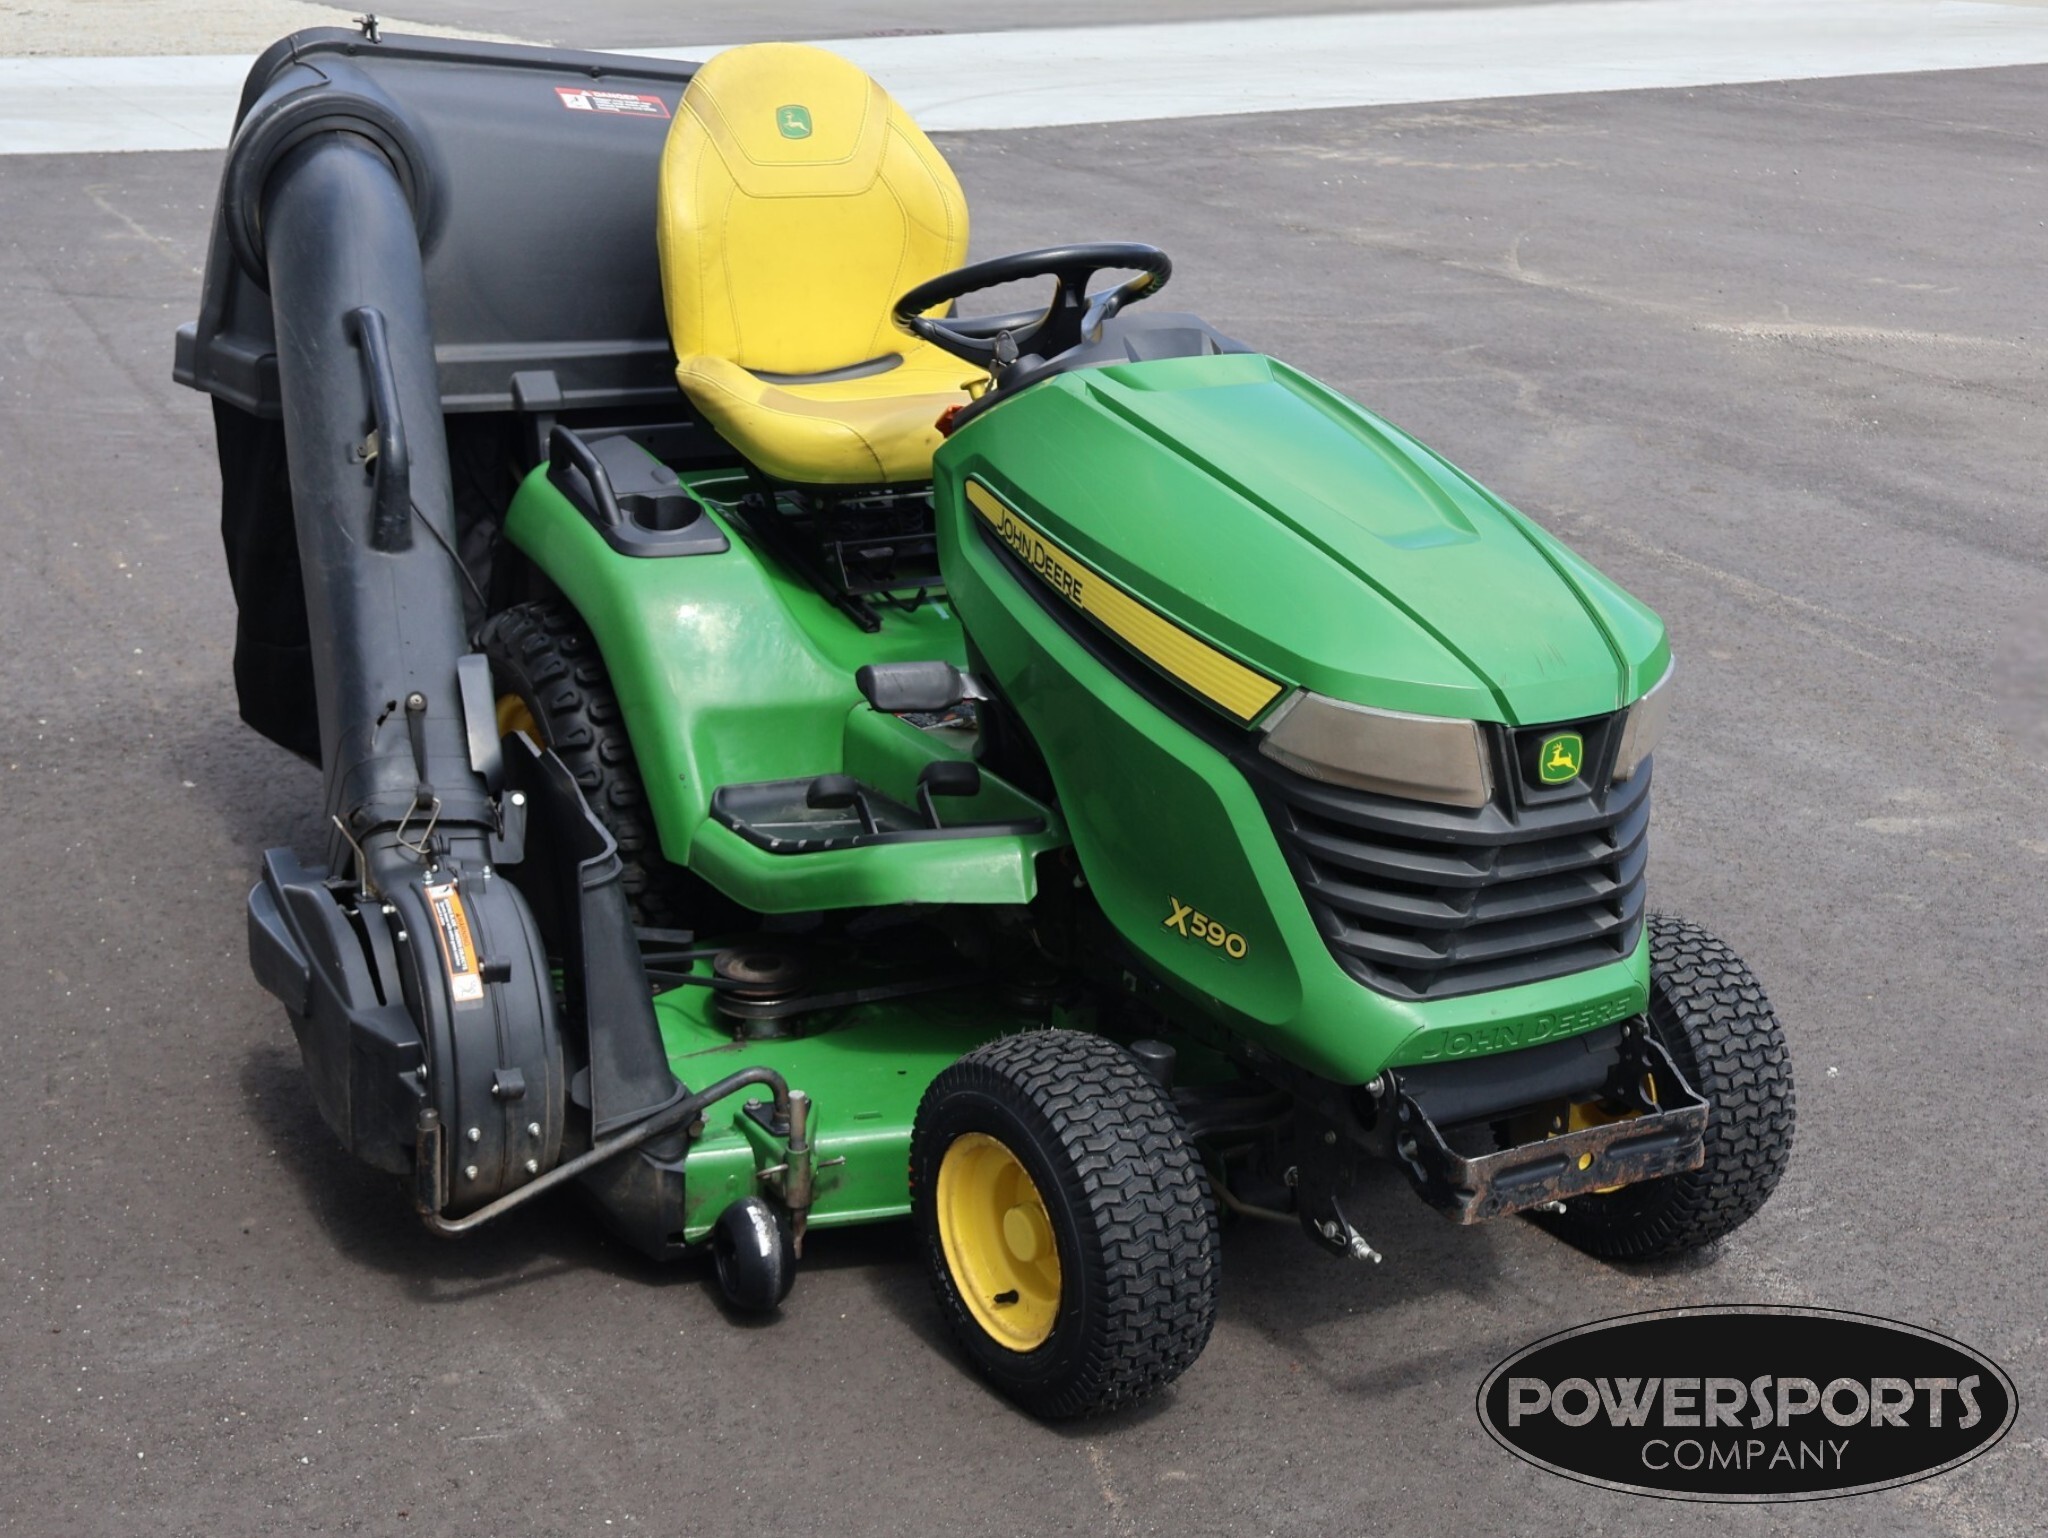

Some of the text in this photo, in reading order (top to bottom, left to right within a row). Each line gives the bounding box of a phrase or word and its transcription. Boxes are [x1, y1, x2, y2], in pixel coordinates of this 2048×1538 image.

[997, 508, 1083, 605] JOHN DEERE
[1163, 895, 1247, 958] X590
[1422, 997, 1631, 1059] JOHN DEERE
